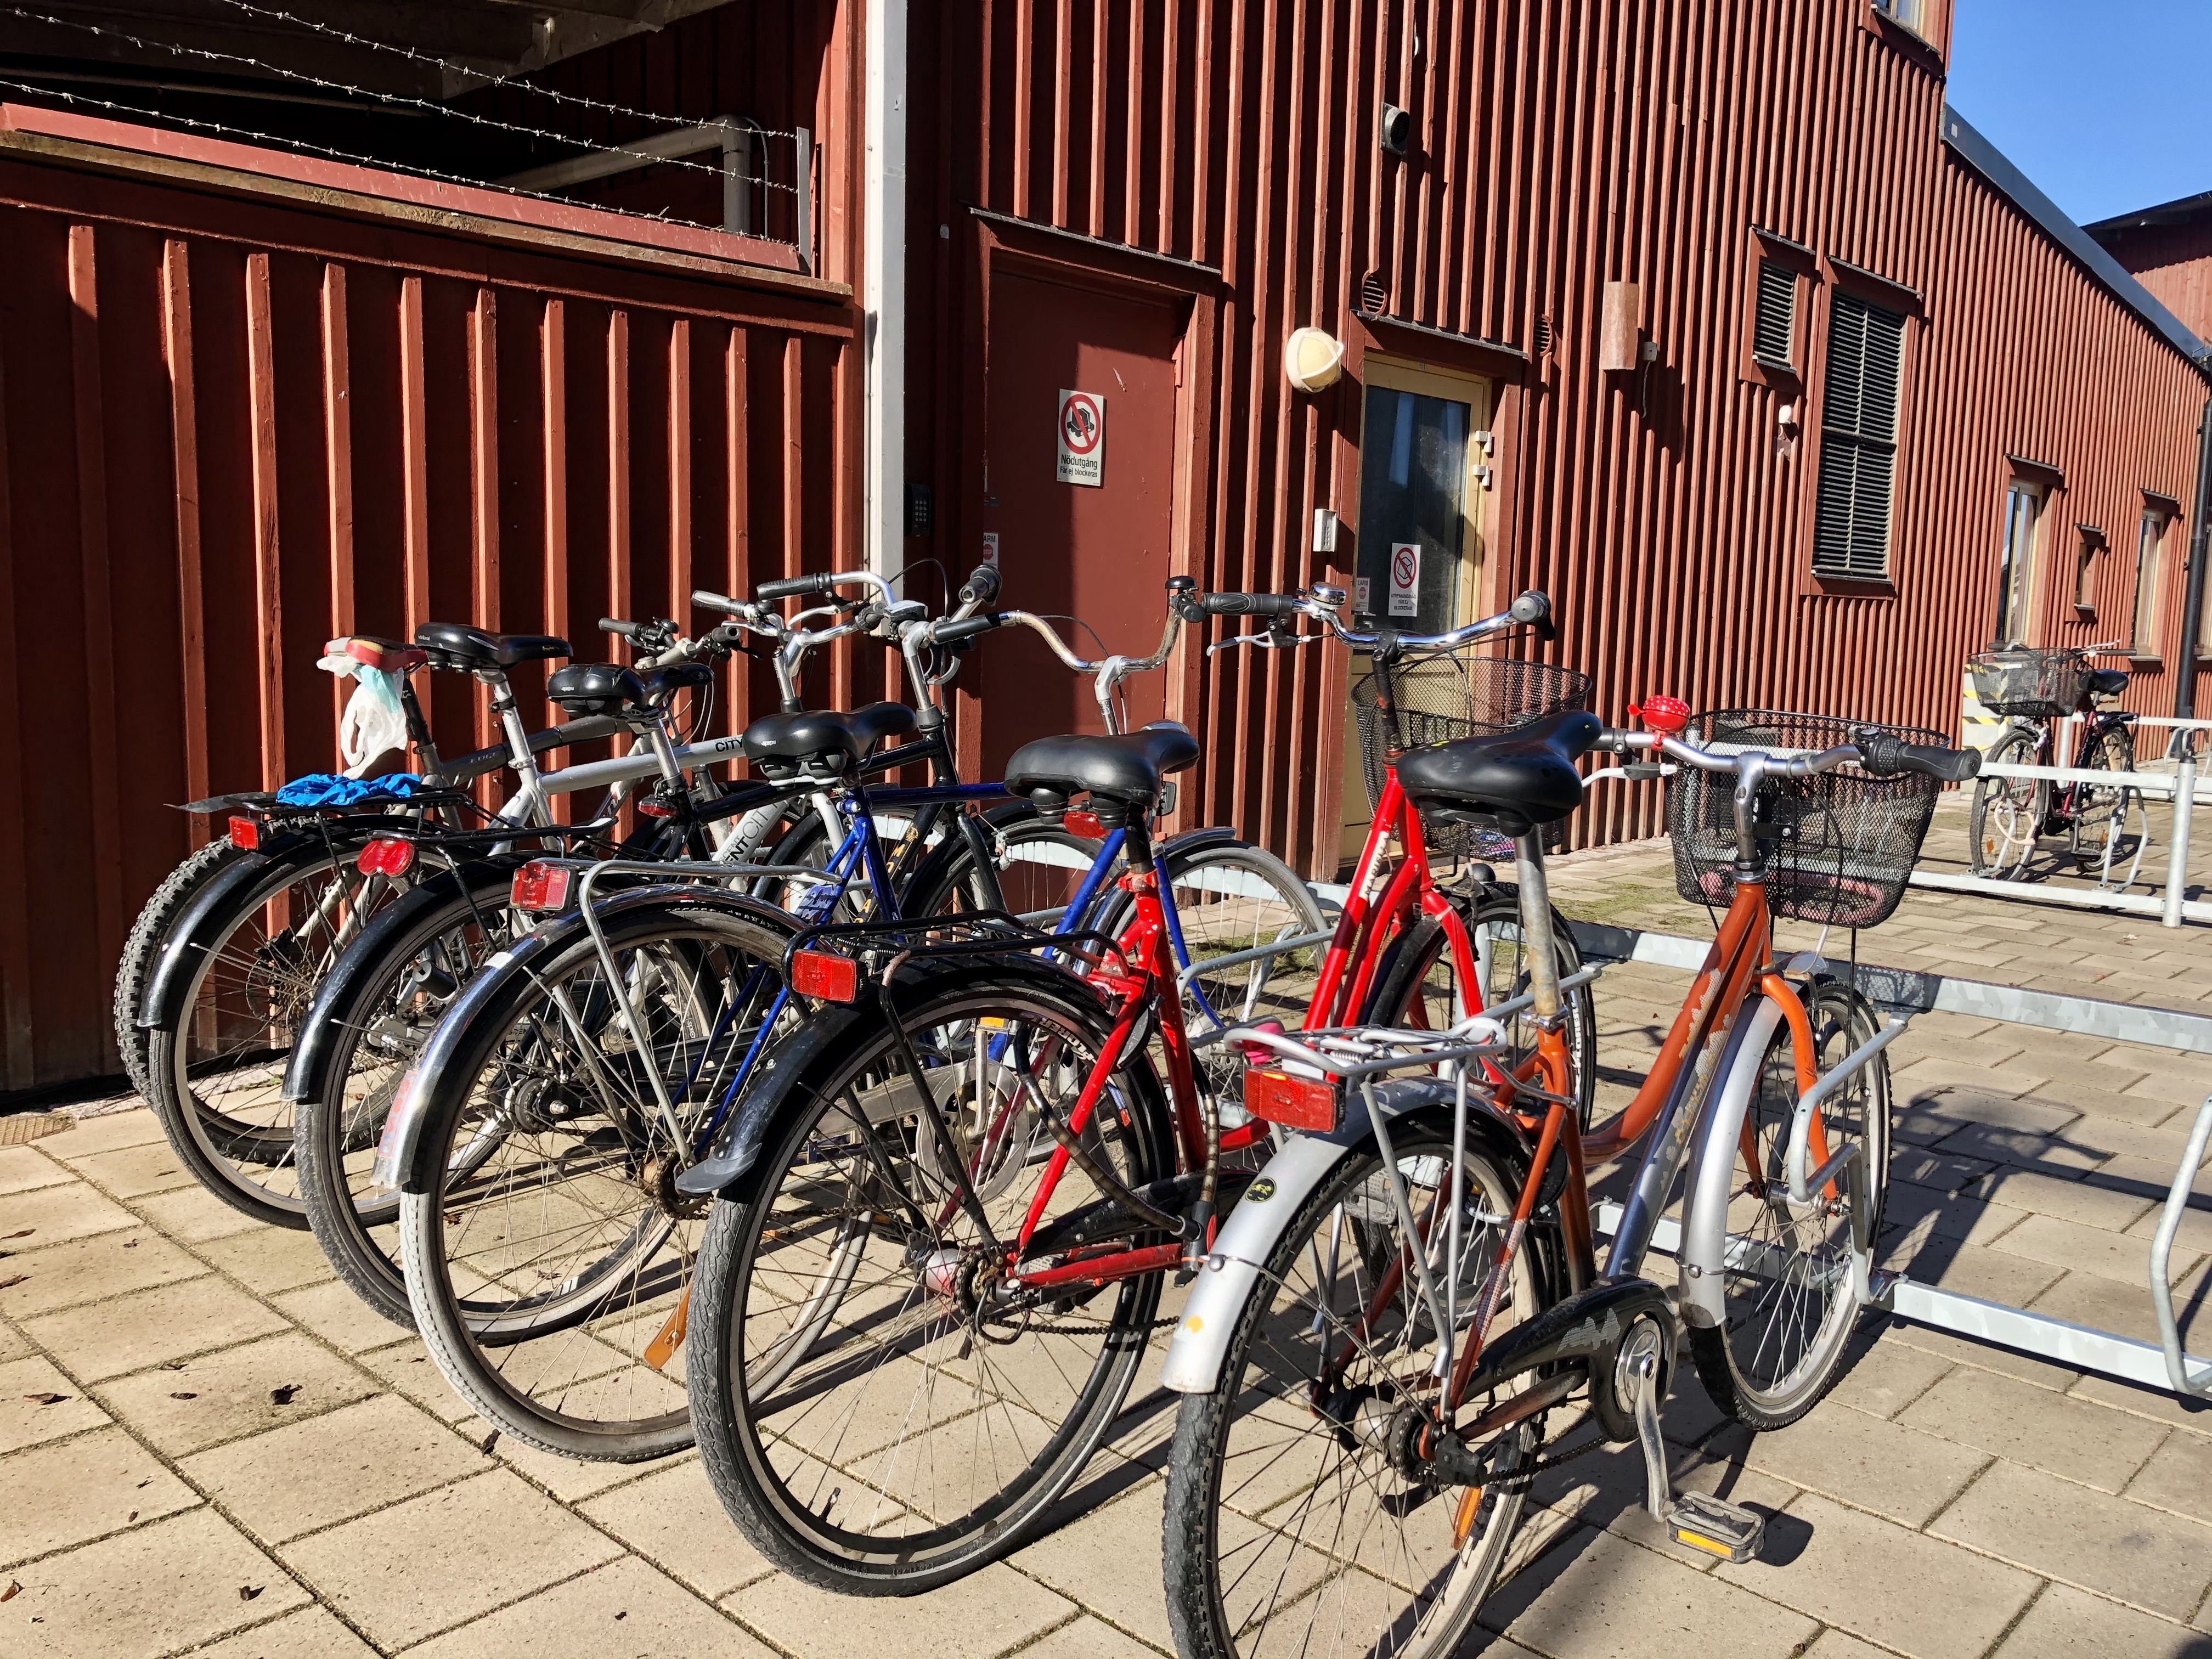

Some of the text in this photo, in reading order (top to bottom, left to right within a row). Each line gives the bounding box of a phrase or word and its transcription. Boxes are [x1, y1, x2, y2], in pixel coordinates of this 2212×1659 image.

[1060, 454, 1098, 470] Nödutgång
[1068, 467, 1074, 476] ej
[1074, 469, 1098, 477] blockeras
